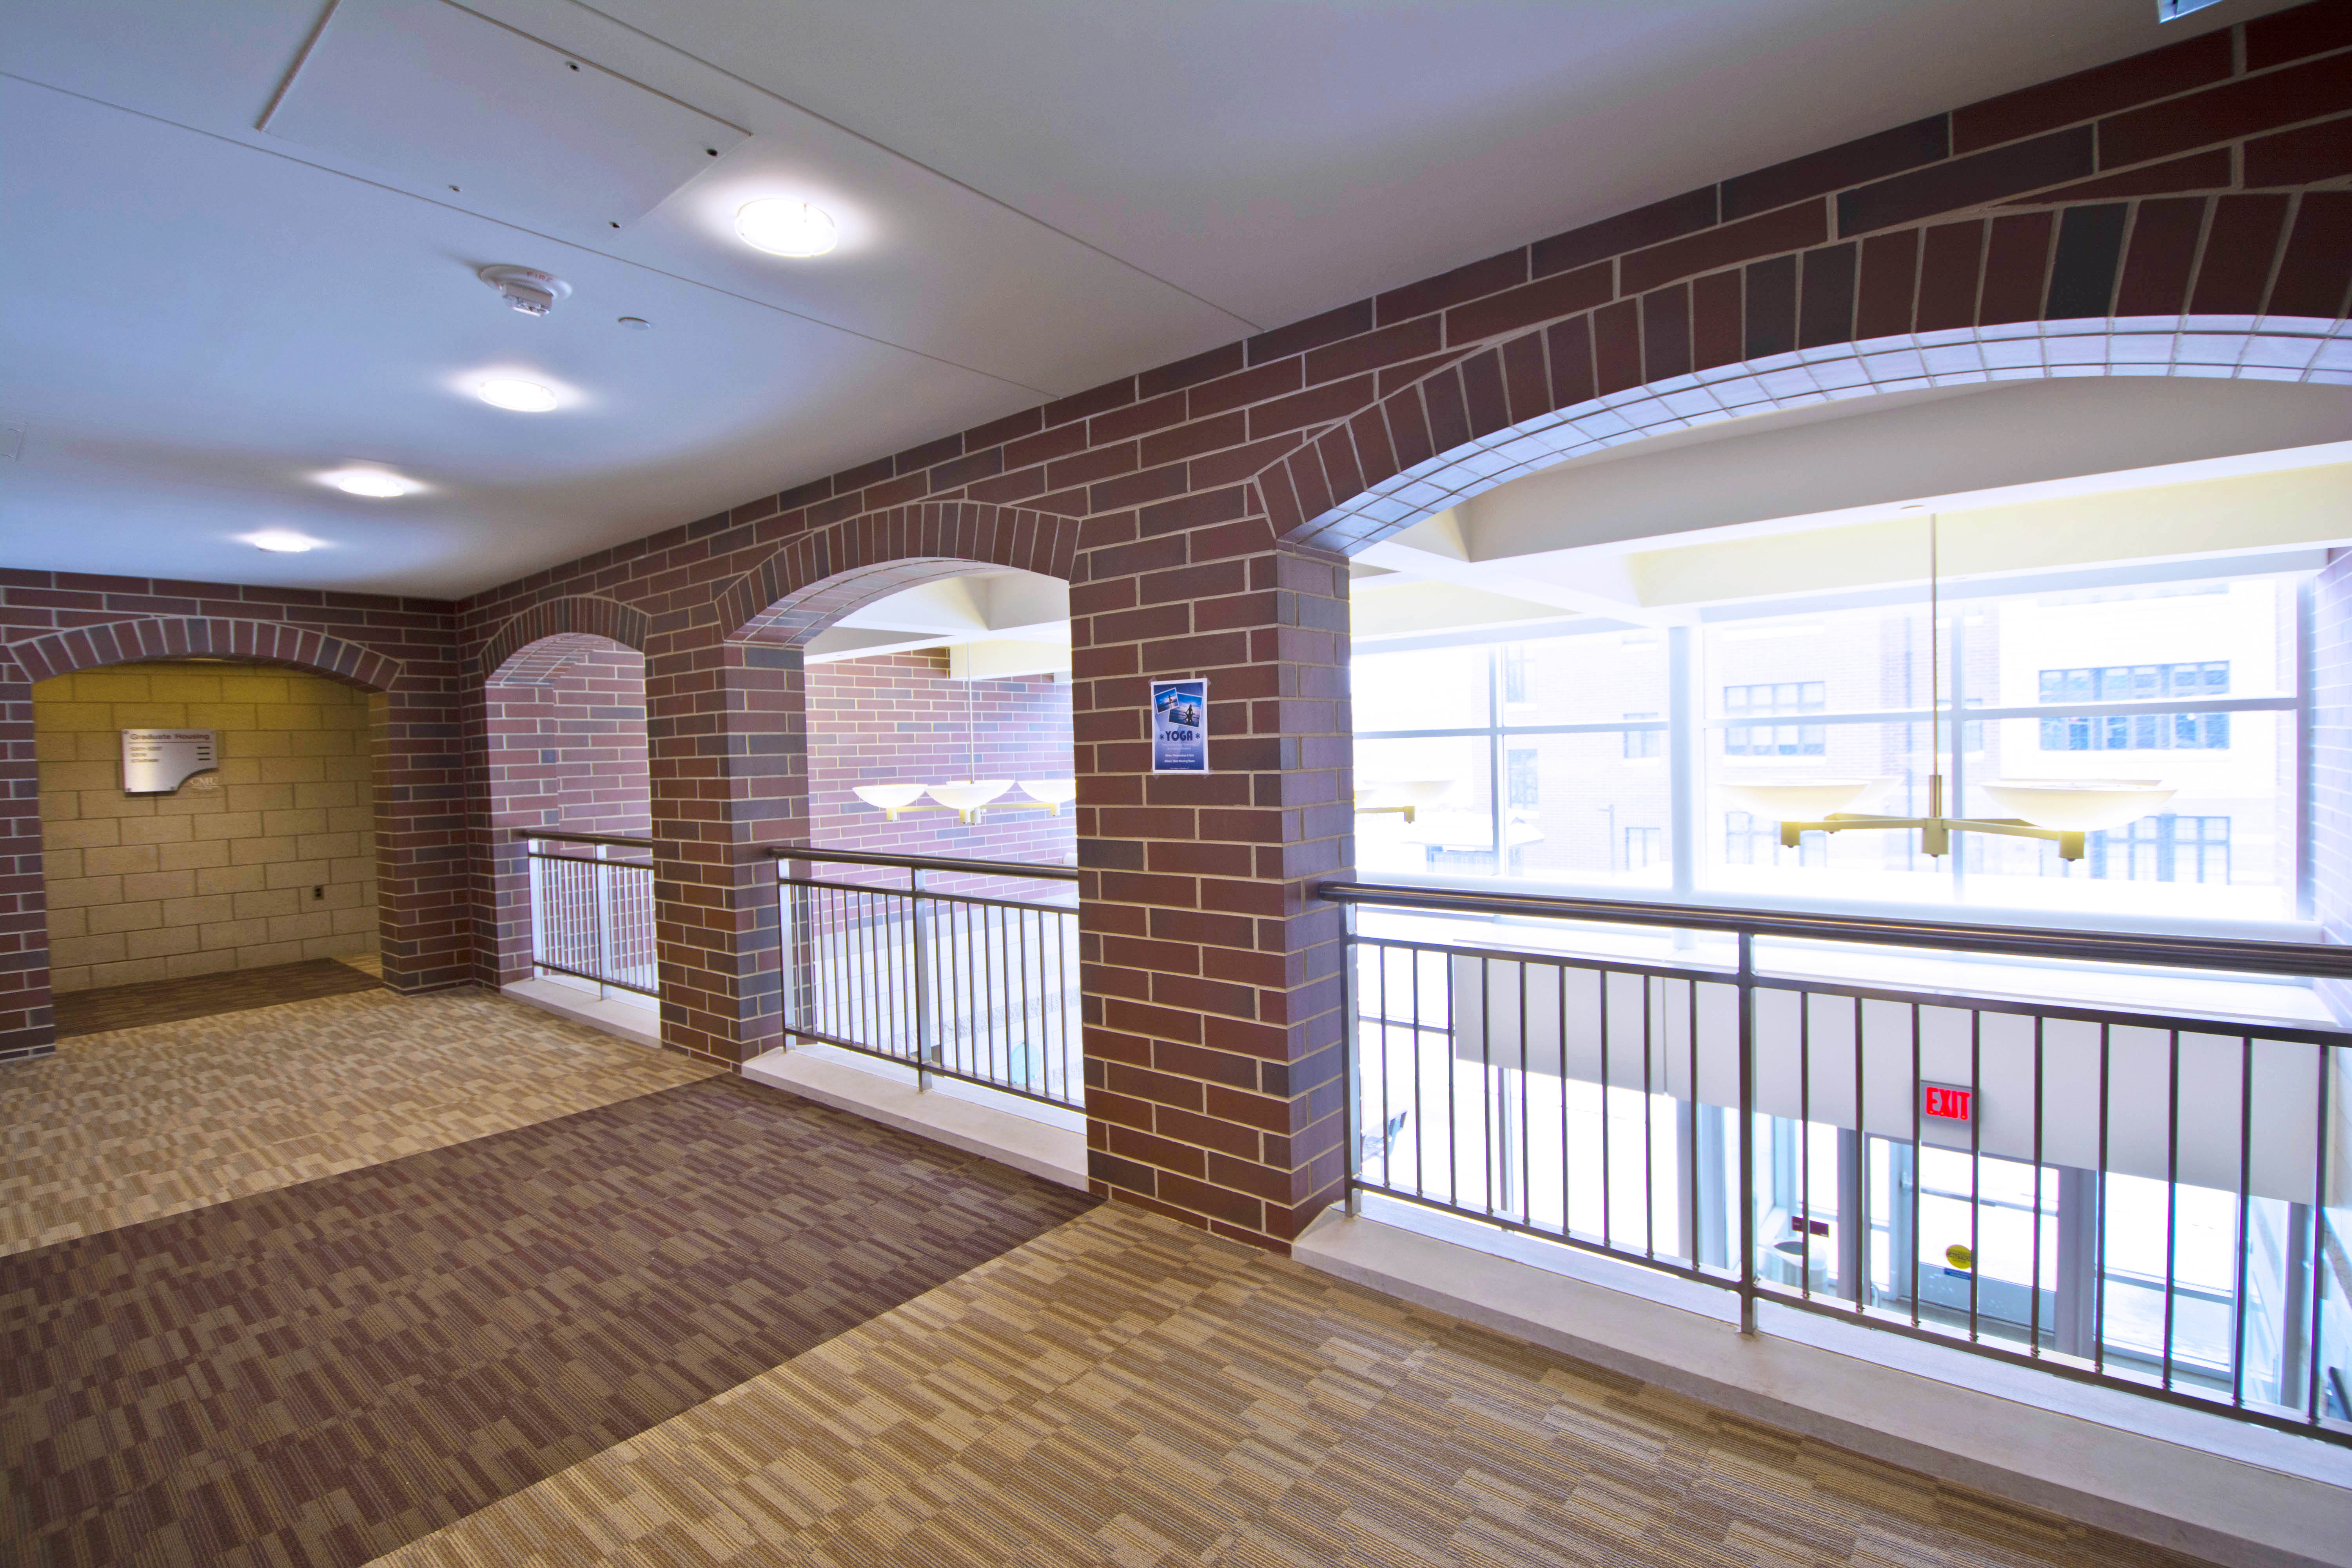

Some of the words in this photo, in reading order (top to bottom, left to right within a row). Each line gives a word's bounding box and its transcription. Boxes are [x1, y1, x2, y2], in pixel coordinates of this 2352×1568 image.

[527, 271, 553, 282] FIRE
[1165, 730, 1193, 741] YOGA
[1926, 1086, 1971, 1120] EXIT
